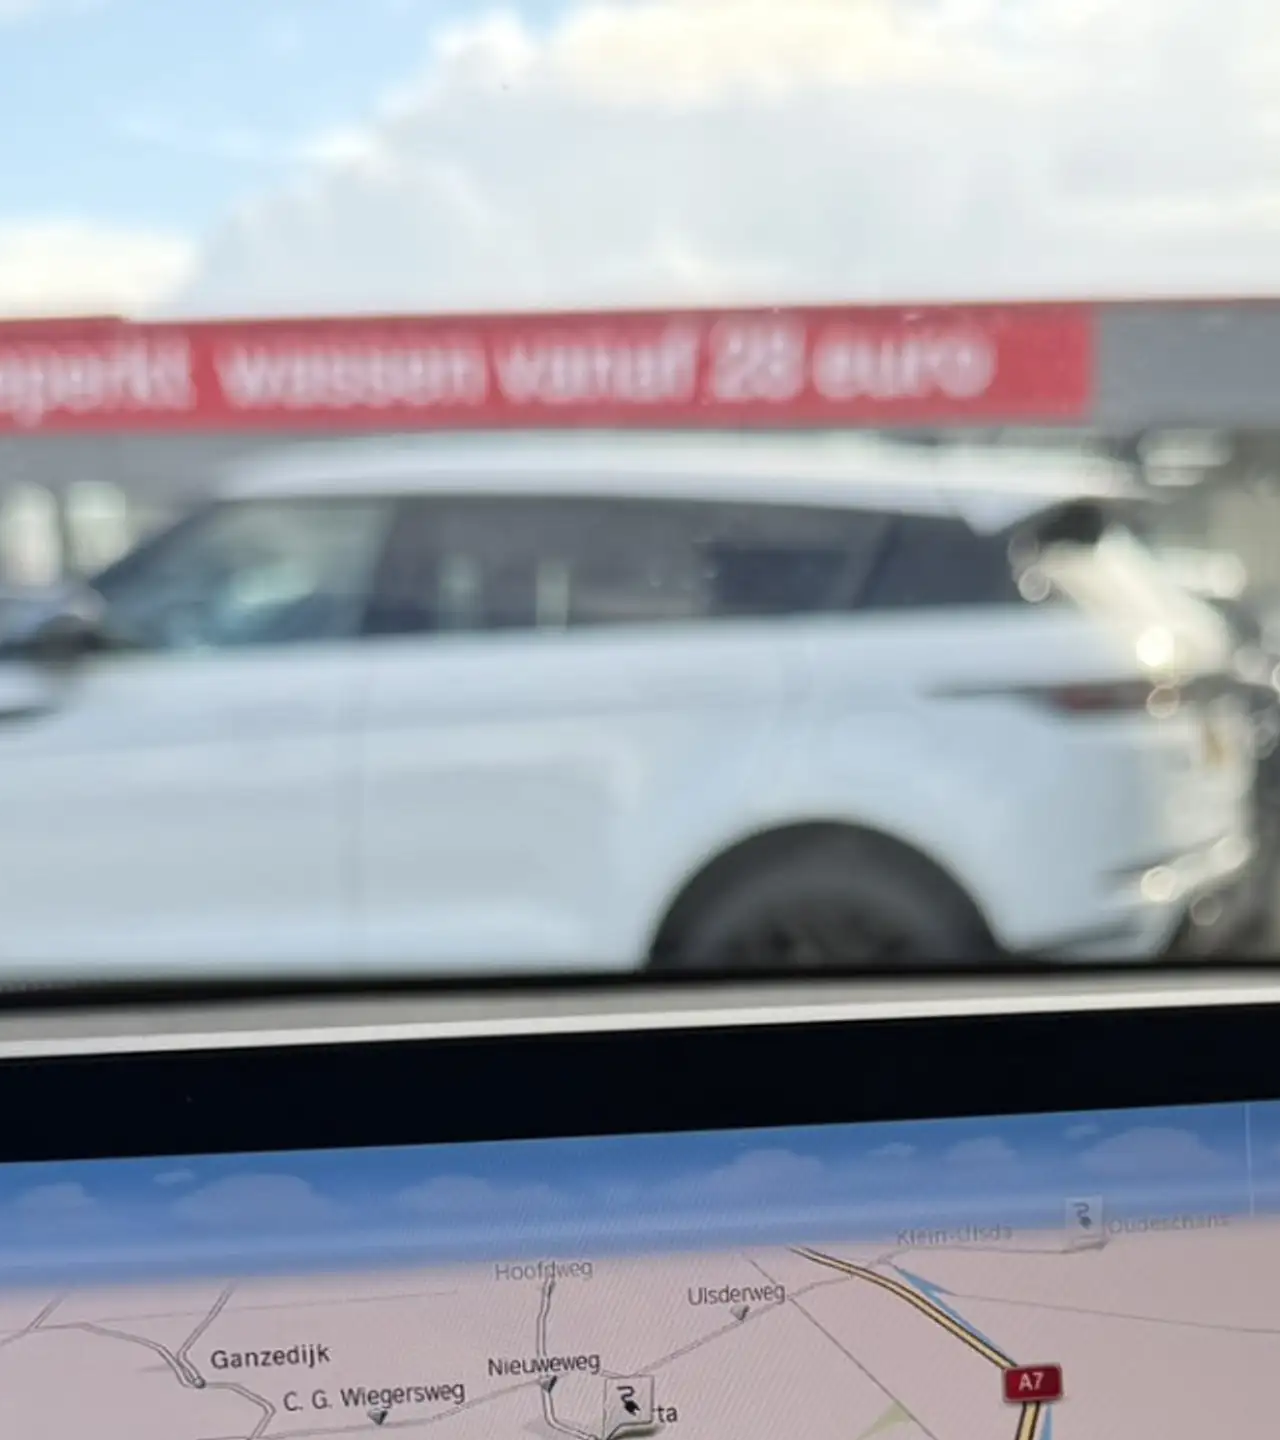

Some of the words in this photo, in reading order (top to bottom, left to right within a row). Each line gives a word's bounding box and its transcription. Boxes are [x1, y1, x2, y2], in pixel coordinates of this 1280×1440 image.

[214, 340, 486, 412] wassen
[494, 314, 698, 404] vanaf
[810, 330, 1000, 400] euro
[494, 1258, 594, 1284] Hoofdweg
[686, 1280, 787, 1308] Ulsderweg
[209, 1343, 332, 1373] Ganzedijk
[487, 1351, 601, 1380] Nieuweweg
[282, 1391, 300, 1414] C.
[311, 1389, 332, 1412] G.
[339, 1378, 466, 1410] Wiegersweg
[1018, 1371, 1045, 1393] A7
